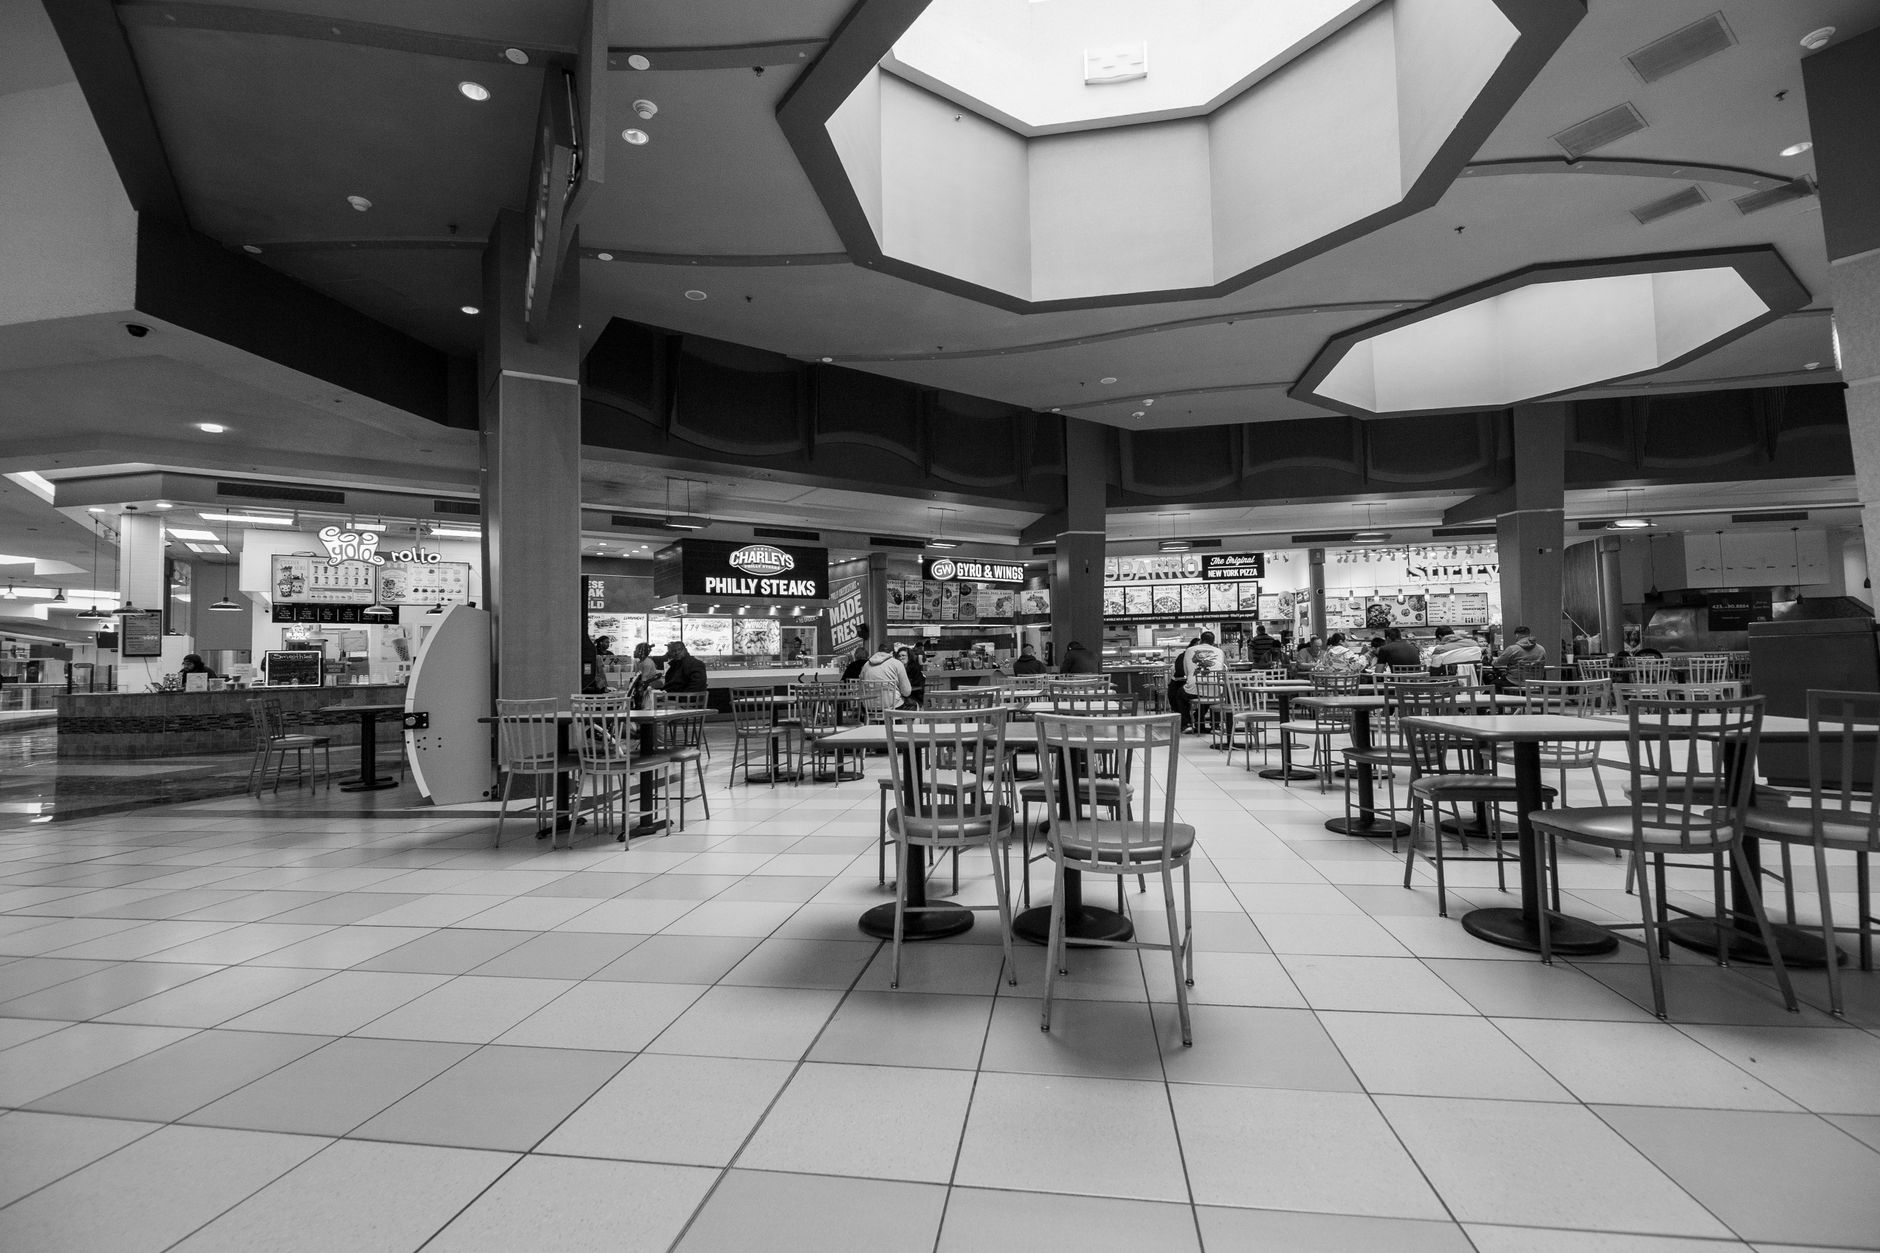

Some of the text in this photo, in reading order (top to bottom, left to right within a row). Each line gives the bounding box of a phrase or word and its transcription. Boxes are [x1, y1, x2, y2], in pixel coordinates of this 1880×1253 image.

[391, 547, 441, 564] rollo
[730, 550, 794, 569] CHARLEYS
[1210, 555, 1256, 566] The Original
[933, 564, 952, 577] GW
[957, 562, 1024, 580] GYRO & WINGS
[1104, 557, 1199, 582] SBARRO
[1208, 568, 1258, 578] NEW YORK PIZZA
[705, 576, 758, 595] PHILLY
[760, 578, 816, 596] STEAKS
[829, 593, 863, 627] MADE
